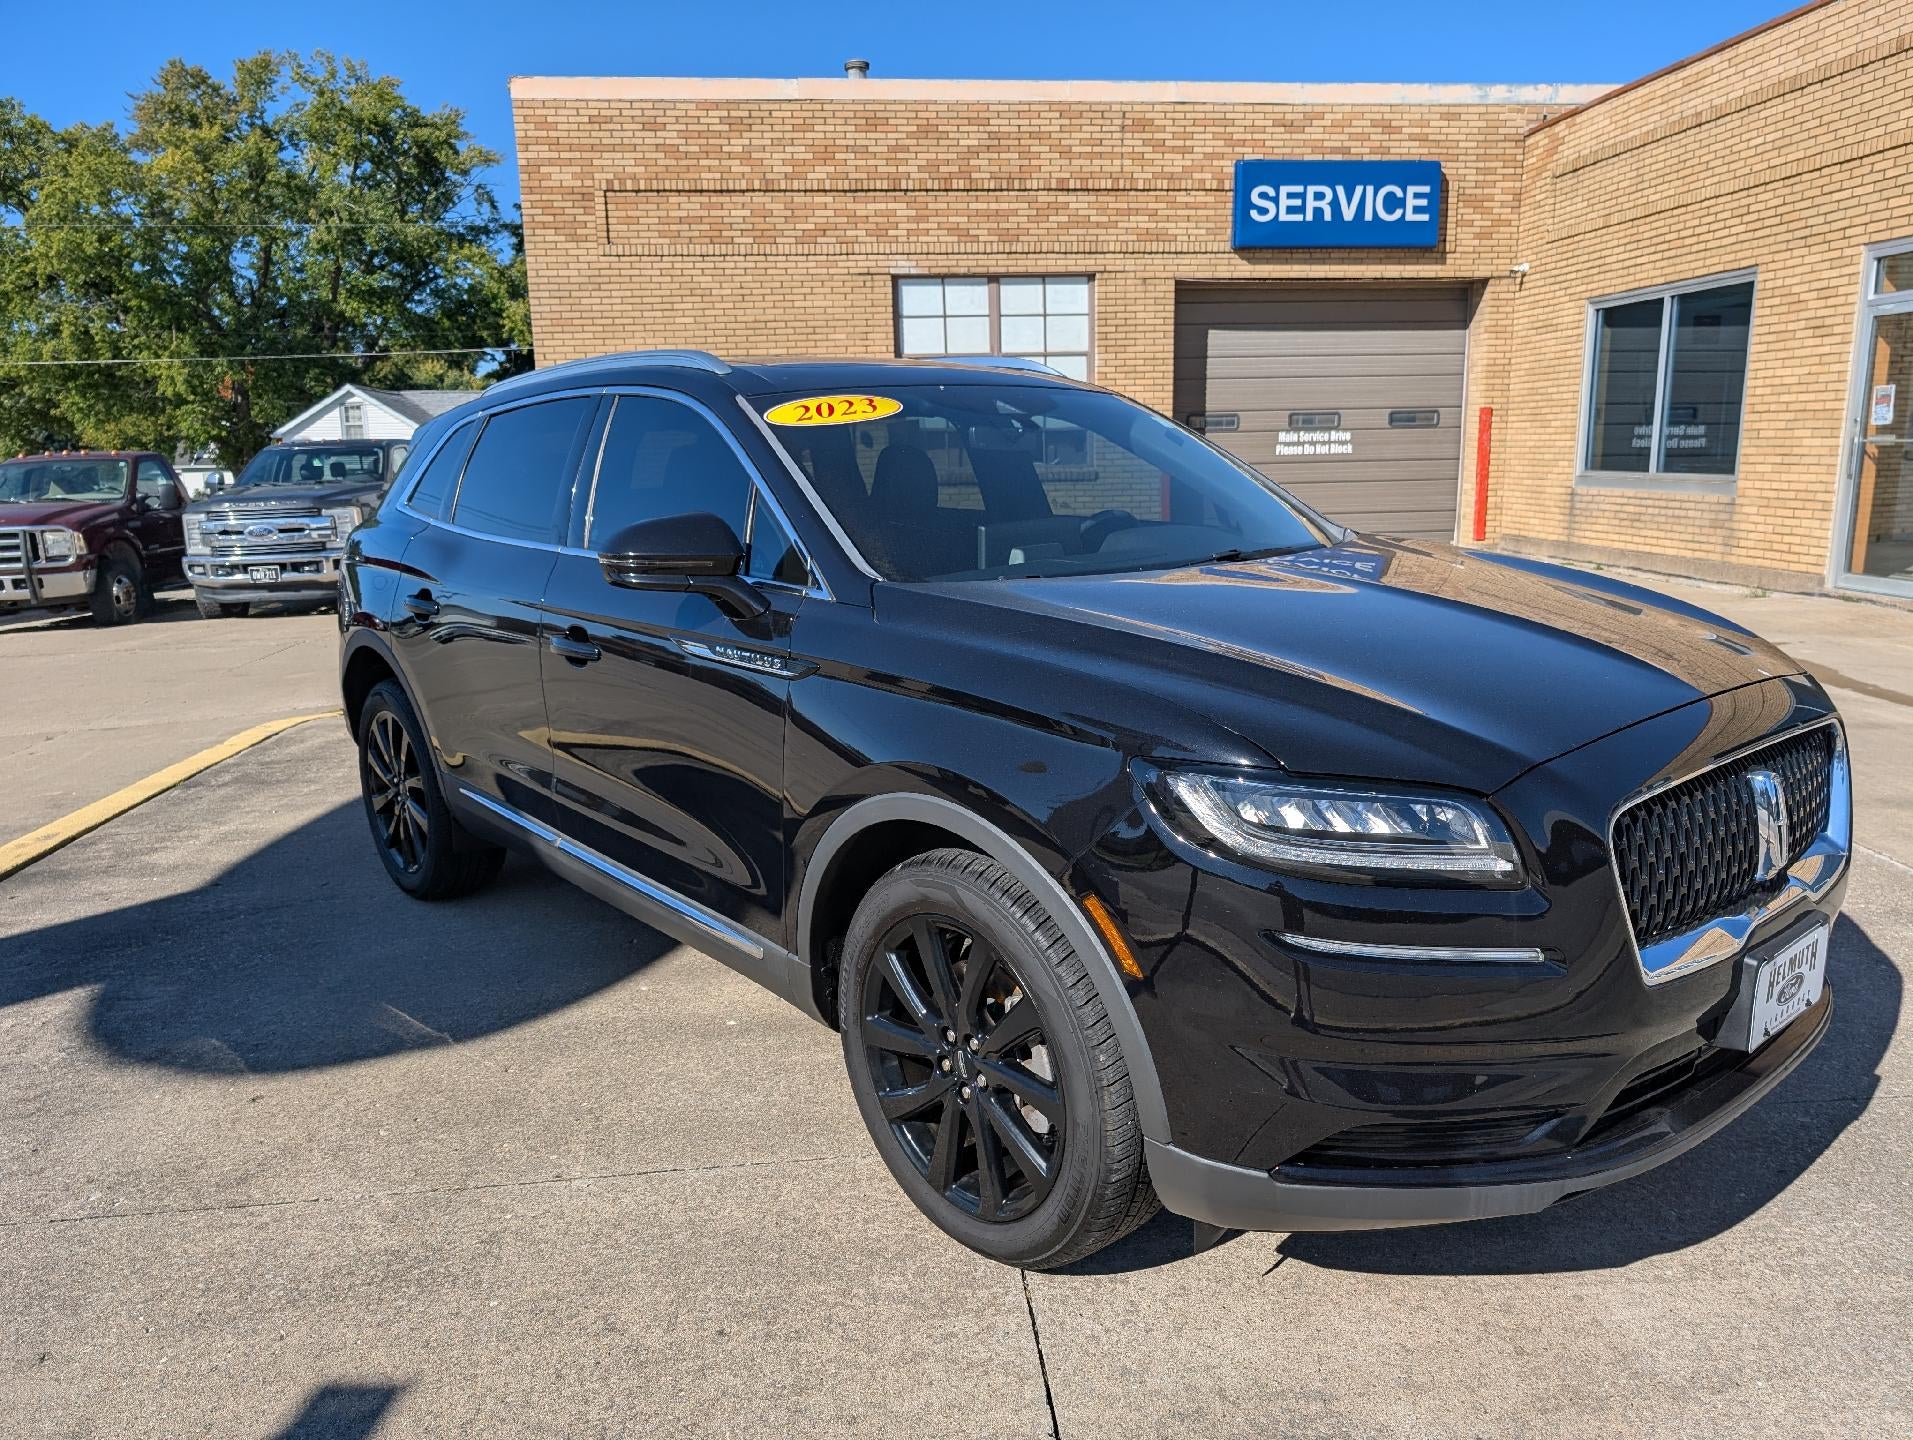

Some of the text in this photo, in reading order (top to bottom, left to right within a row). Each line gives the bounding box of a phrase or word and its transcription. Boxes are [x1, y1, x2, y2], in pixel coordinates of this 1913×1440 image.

[1250, 184, 1431, 223] SERVICE
[794, 398, 878, 422] 2023
[1278, 430, 1351, 442] Main Service Drive
[1275, 443, 1352, 455] Please Do Not Block
[715, 646, 781, 669] NAUTILUS
[1765, 938, 1819, 1005] HELMUTH
